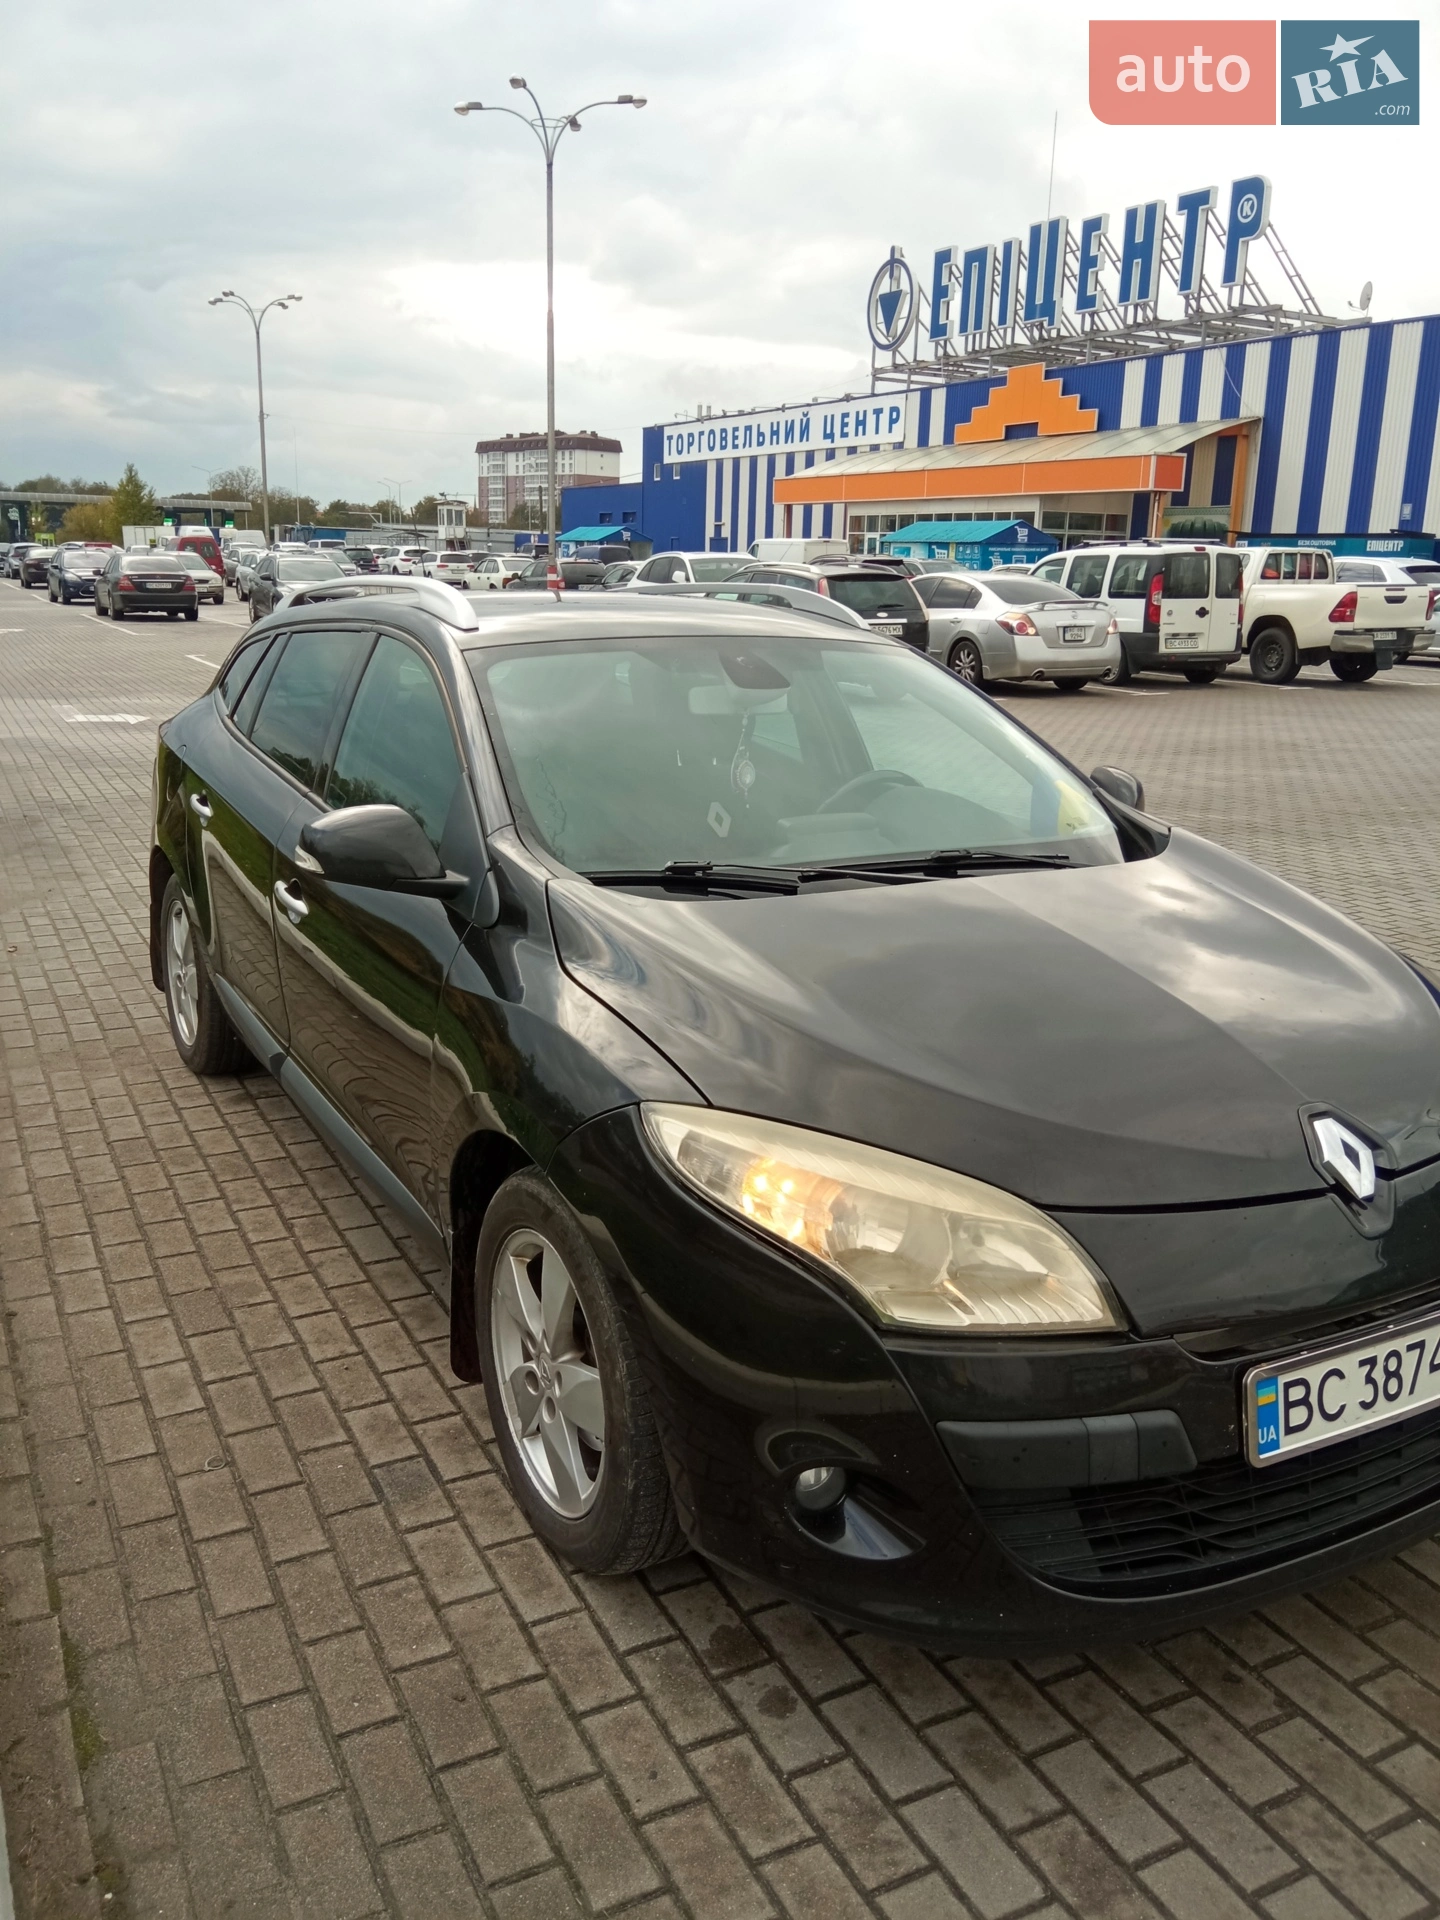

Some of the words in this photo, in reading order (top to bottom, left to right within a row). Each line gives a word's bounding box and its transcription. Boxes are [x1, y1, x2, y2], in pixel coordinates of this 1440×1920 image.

[929, 175, 1271, 342] ЕПІЦЕНТР
[666, 411, 811, 456] ТОРГОВЕЛЬНИЙ
[823, 406, 901, 443] ЦЕНТР
[1366, 540, 1404, 552] ЕПІЦЕНТР
[1283, 1367, 1347, 1437] BC
[1258, 1424, 1277, 1444] UA
